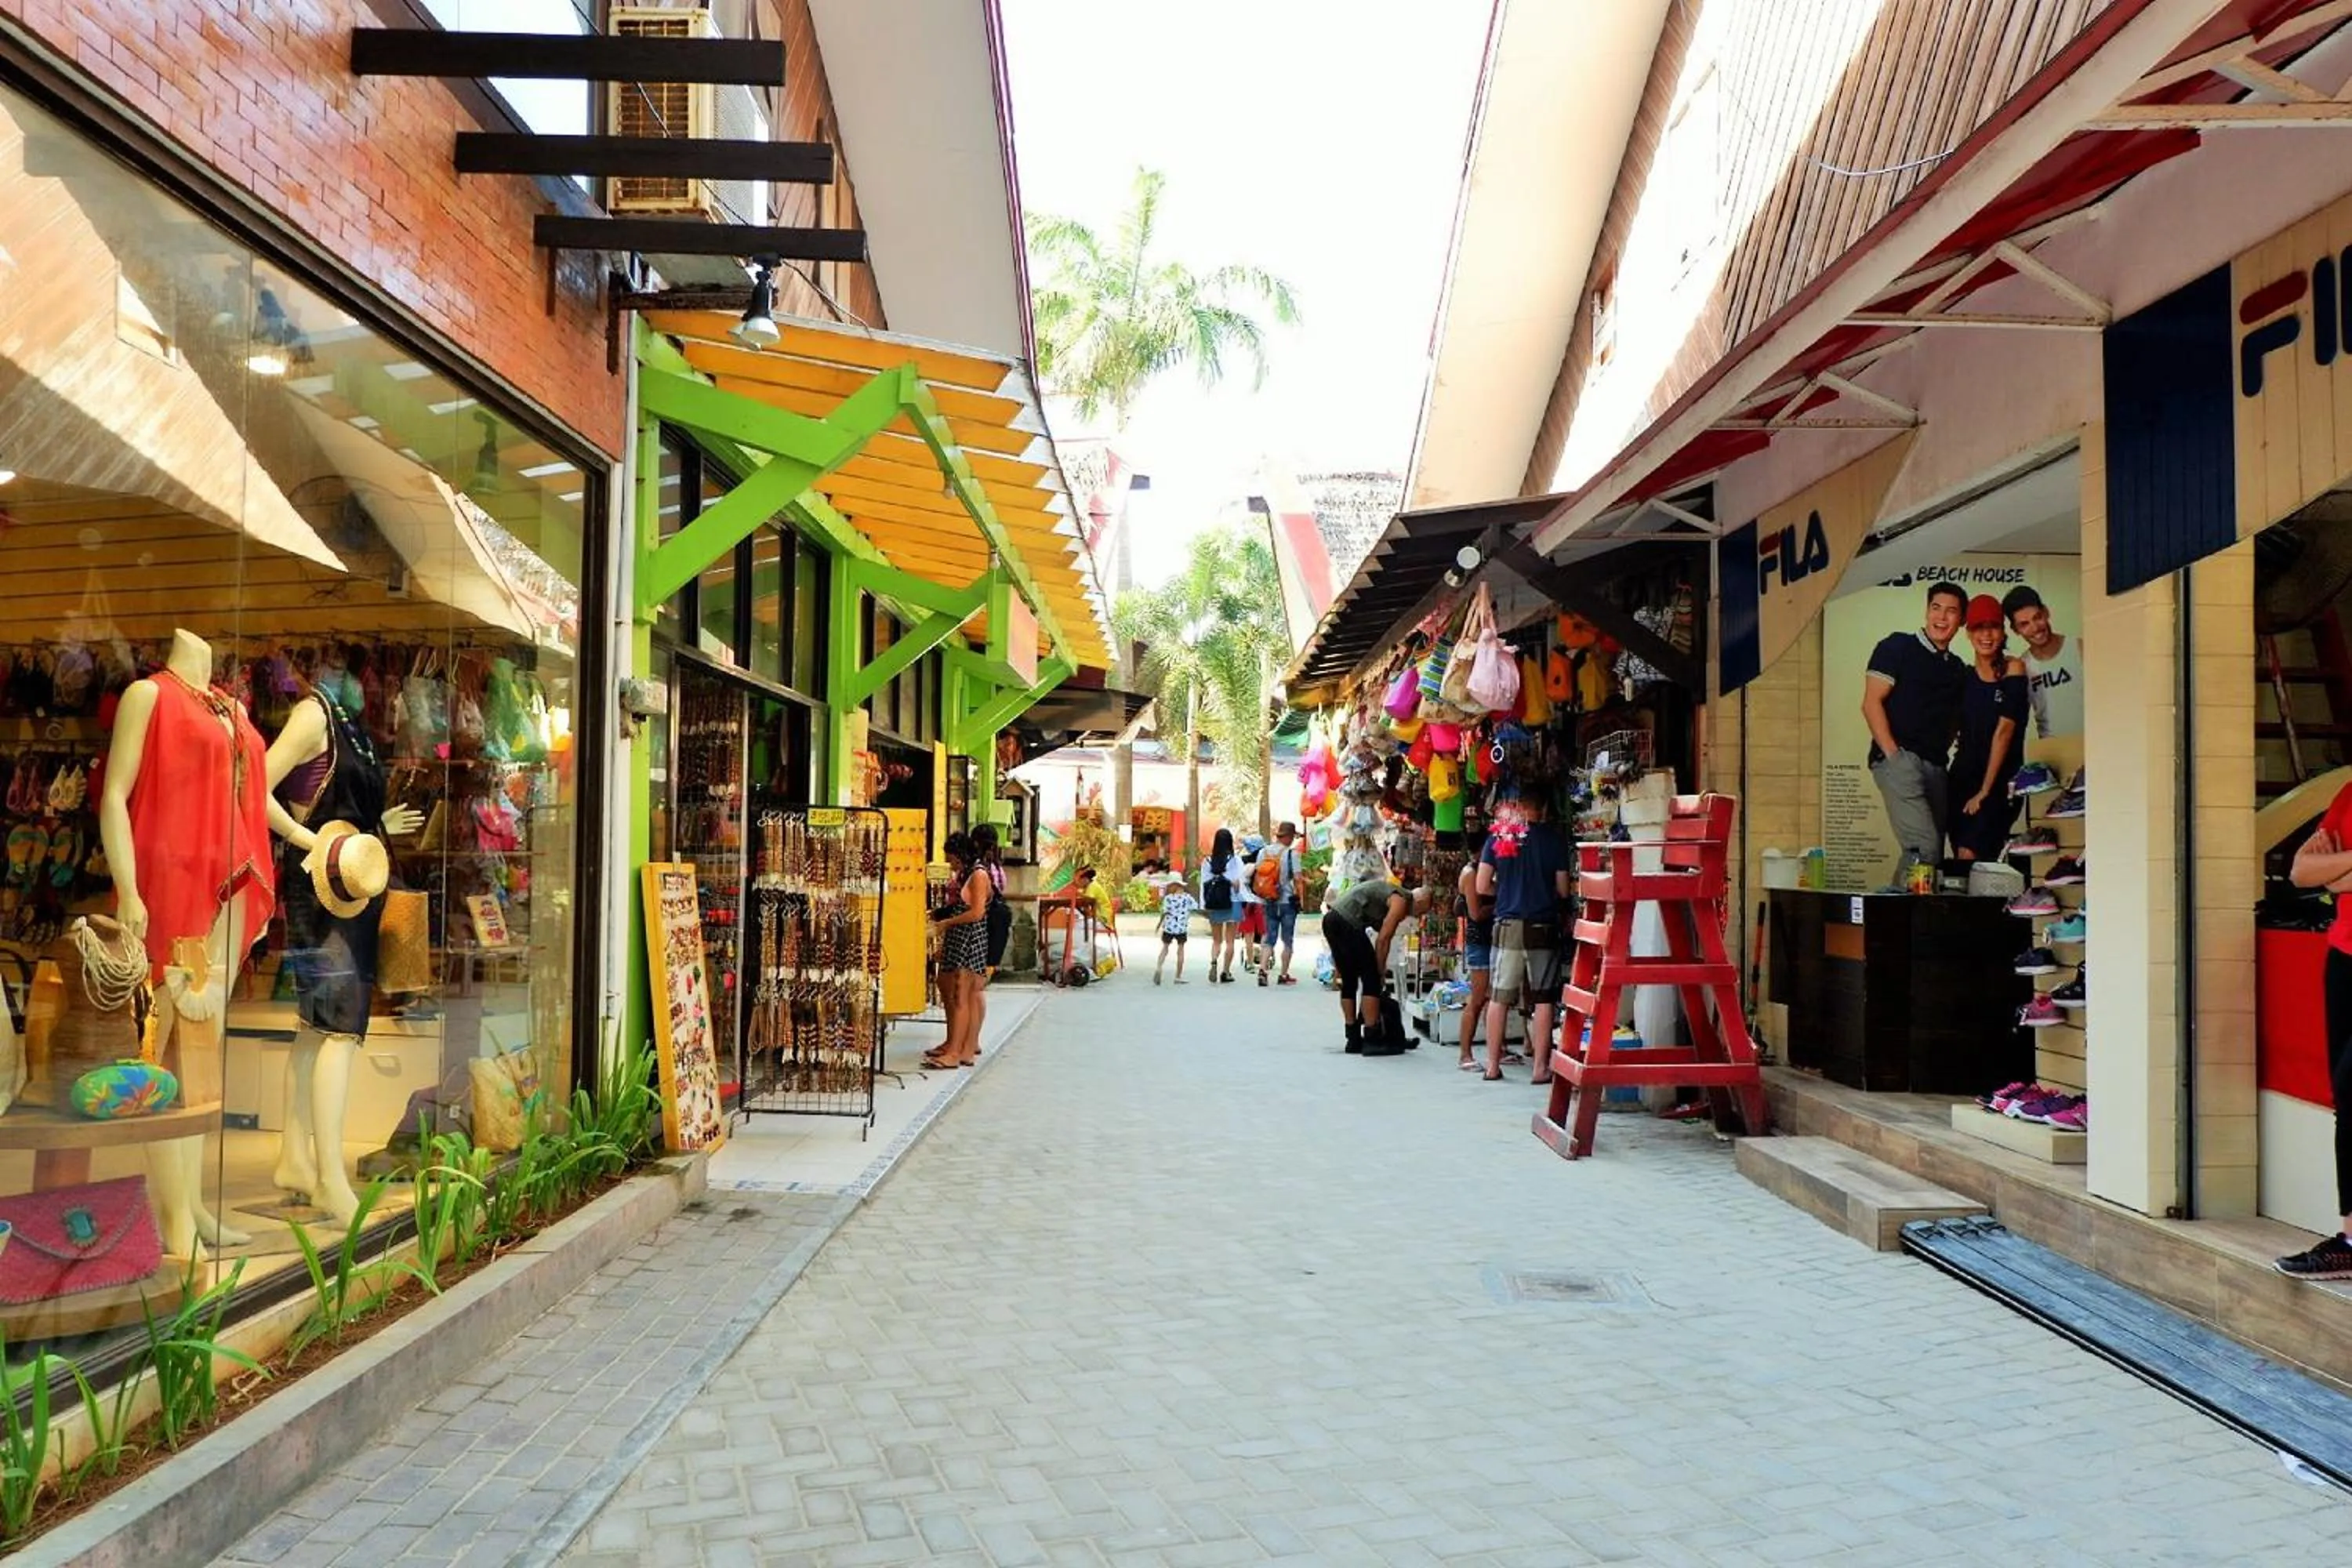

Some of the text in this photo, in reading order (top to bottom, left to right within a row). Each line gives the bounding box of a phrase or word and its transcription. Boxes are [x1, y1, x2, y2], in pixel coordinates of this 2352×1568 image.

[2239, 244, 2352, 397] FI
[1759, 510, 1830, 595] FILA
[1916, 566, 1970, 583] BEACH
[1973, 567, 2025, 583] HOUSE
[2031, 666, 2072, 692] FILA
